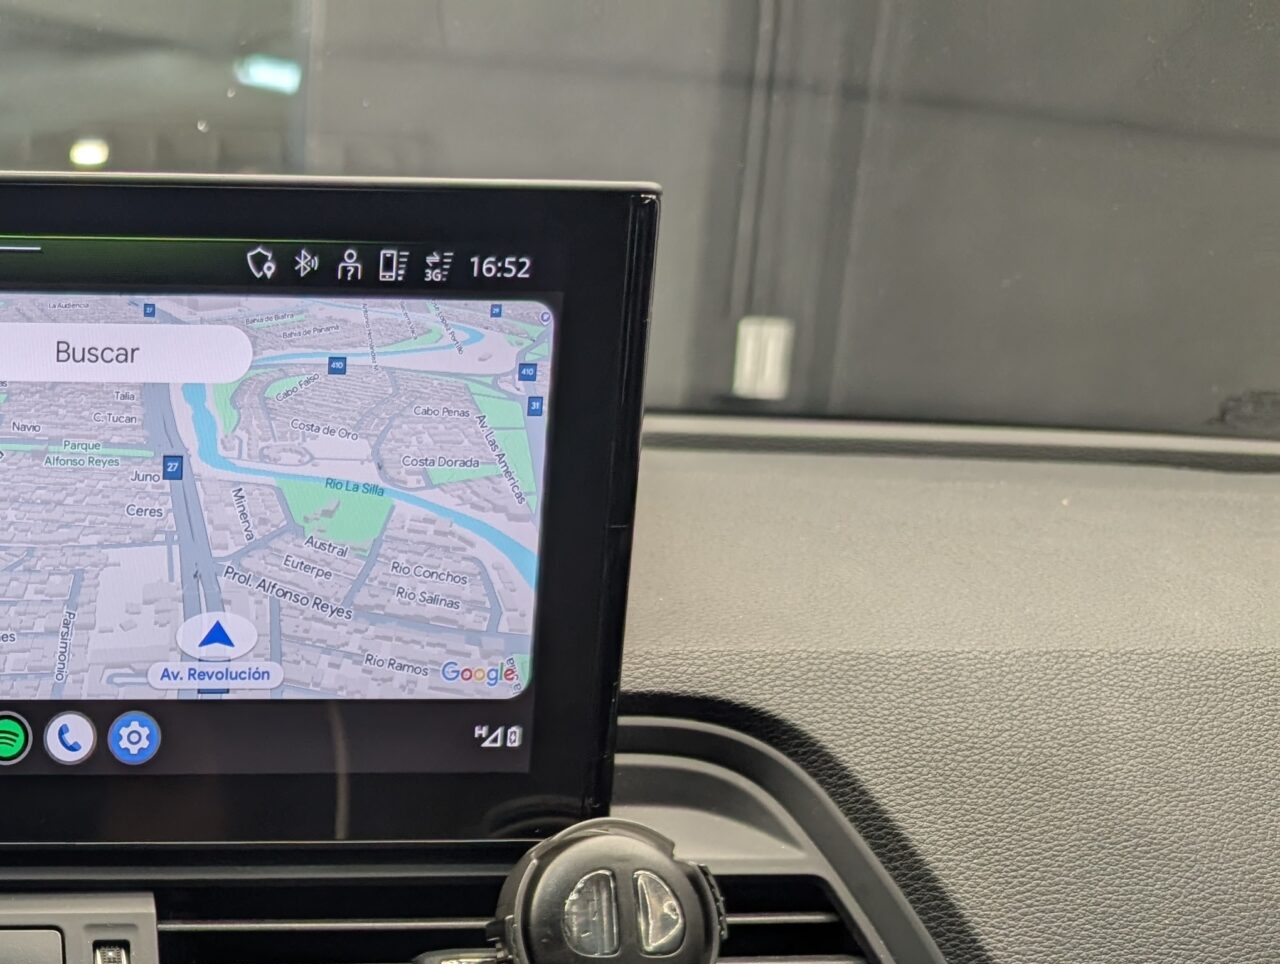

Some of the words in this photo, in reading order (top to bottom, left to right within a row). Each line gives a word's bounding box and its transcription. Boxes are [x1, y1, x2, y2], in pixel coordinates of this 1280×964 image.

[424, 269, 441, 282] 3G
[470, 256, 531, 278] 16:52
[56, 340, 140, 364] Buscar
[276, 386, 298, 401] Cabo
[298, 373, 320, 389] Falso
[93, 412, 104, 423] C.
[413, 406, 439, 416] Cabo
[291, 419, 321, 433] Costa
[322, 426, 336, 436] de
[338, 428, 359, 441] Oro
[476, 415, 488, 432] Av.
[484, 431, 499, 452] Las
[64, 440, 101, 452] Parque
[44, 456, 85, 467] Alfonso
[88, 456, 120, 468] Reyes
[402, 456, 435, 467] Costa
[438, 457, 480, 468] Dorada
[130, 471, 161, 483] Juno
[345, 480, 359, 493] La
[361, 483, 385, 497] Silla
[126, 504, 163, 517] Ceres
[232, 487, 254, 541] Minerva
[304, 536, 349, 558] Austral
[284, 555, 332, 580] Euterpe
[413, 565, 468, 585] Conchos
[224, 566, 252, 588] Prol.
[256, 578, 310, 606] Alfonso
[312, 597, 353, 620] Reyes
[419, 591, 460, 610] Salinas
[56, 611, 76, 681] Parsimonio
[160, 668, 183, 681] Av.
[188, 667, 270, 681] Revolución
[387, 658, 429, 676] Ramos
[442, 662, 515, 687] Google
